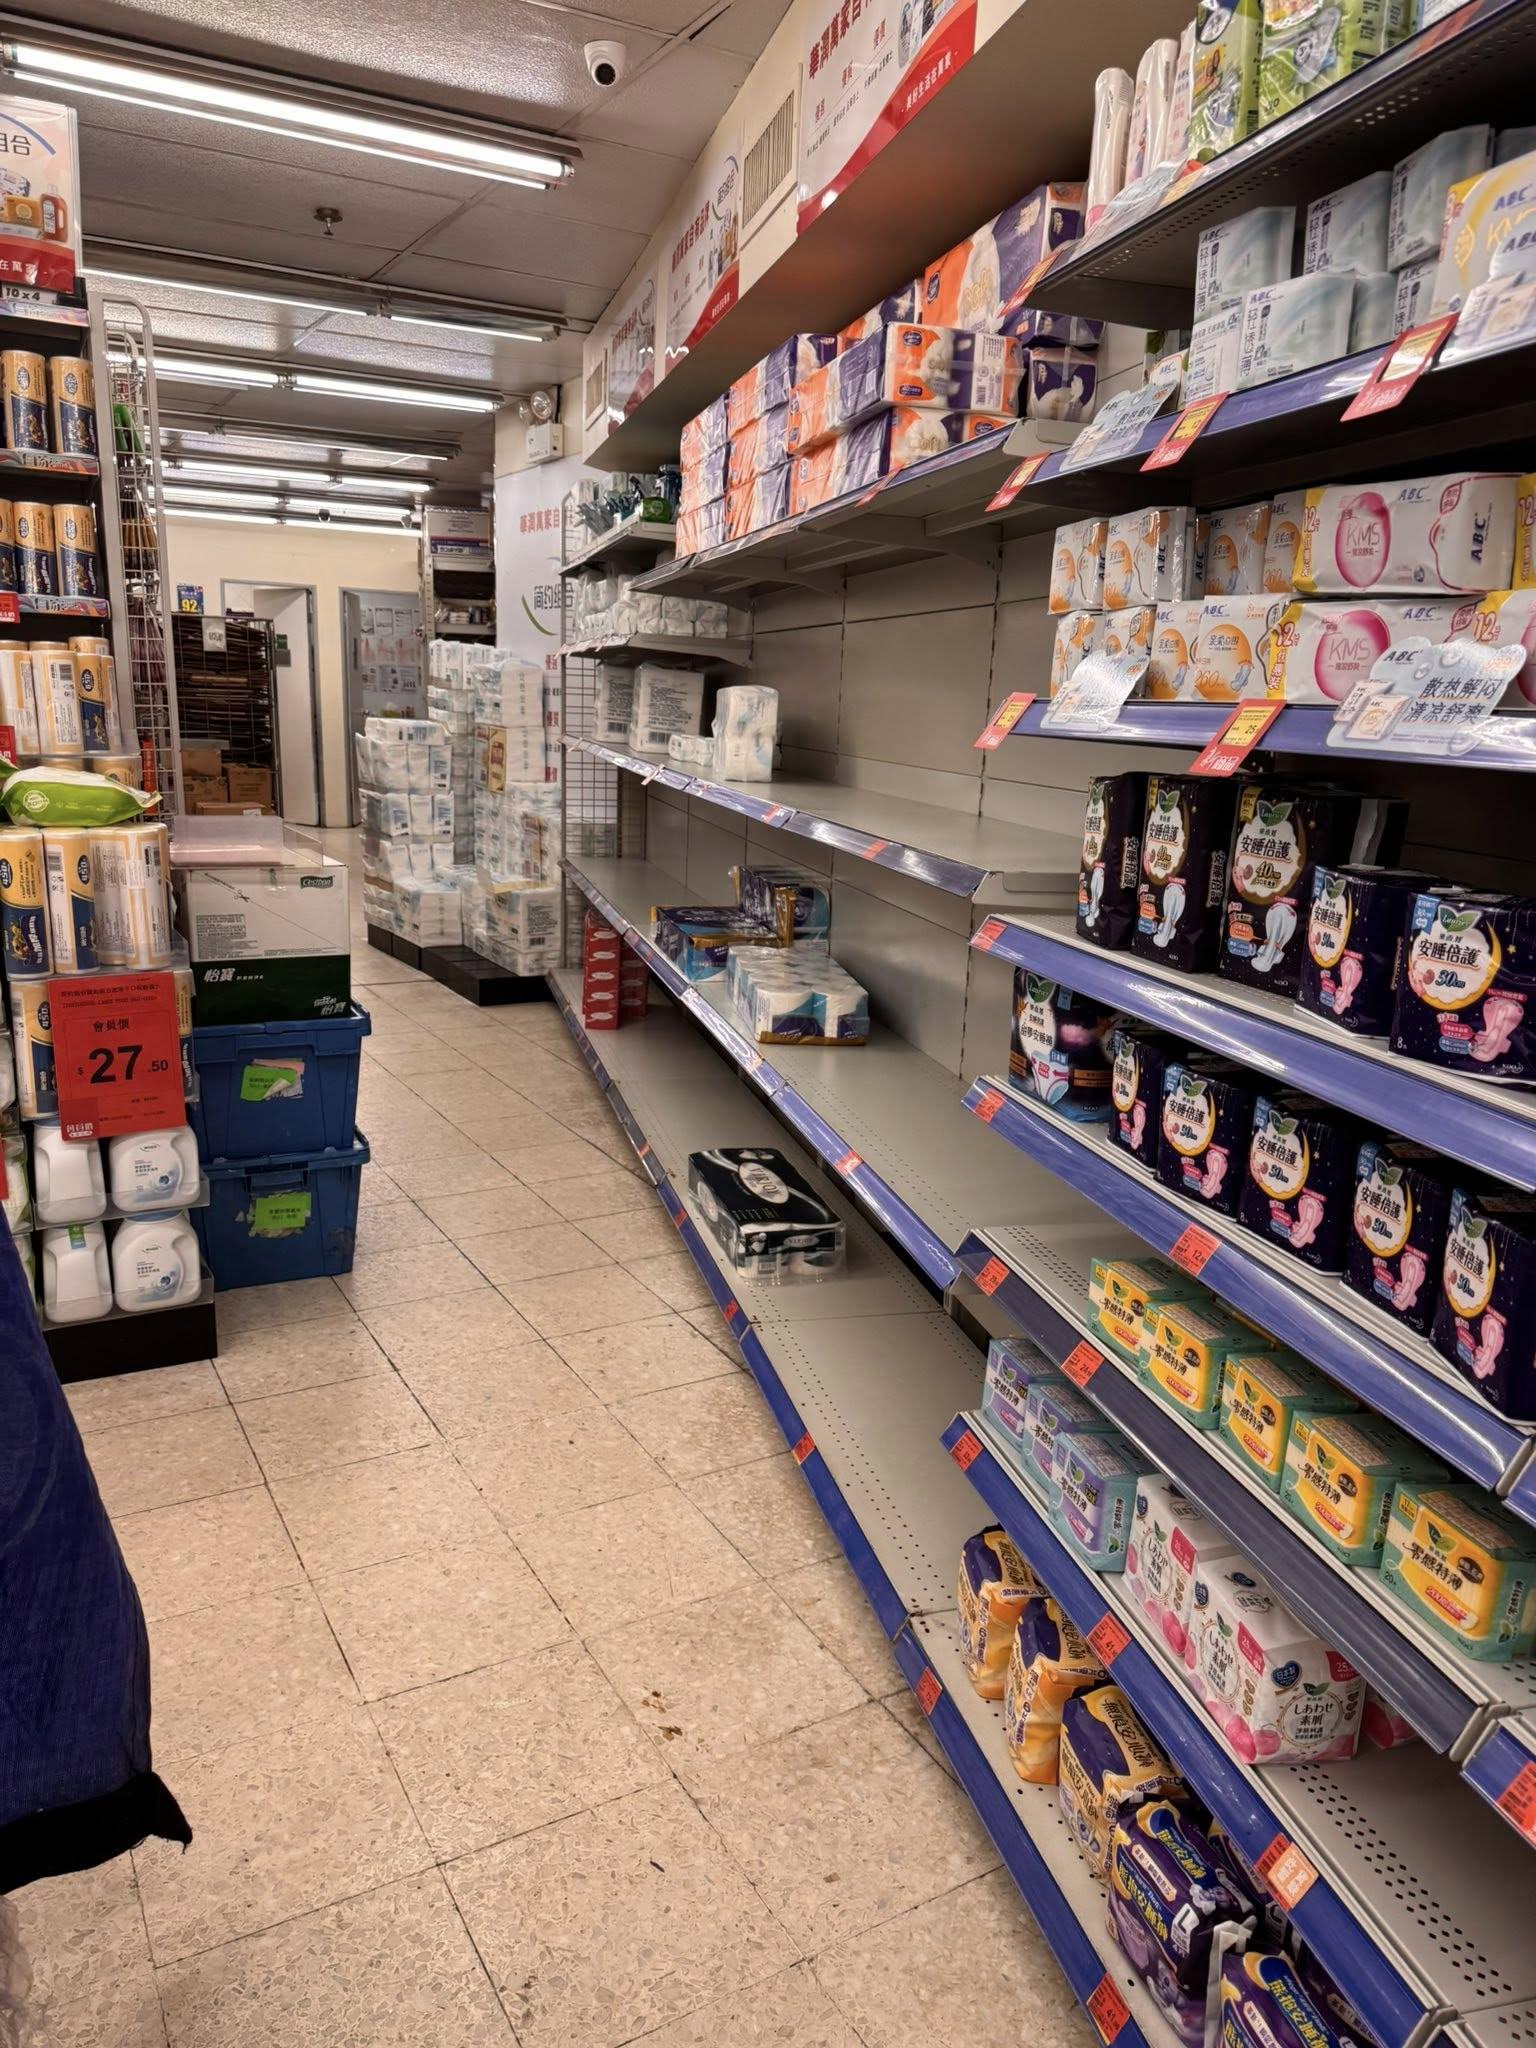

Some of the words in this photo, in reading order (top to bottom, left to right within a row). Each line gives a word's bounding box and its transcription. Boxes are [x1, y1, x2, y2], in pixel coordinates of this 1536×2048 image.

[1400, 487, 1426, 500] ABC
[1345, 522, 1381, 546] KMS
[1471, 515, 1486, 562] ABC
[182, 599, 197, 613] 92
[1203, 604, 1226, 616] ABC
[1402, 606, 1435, 619] ABC
[1329, 637, 1371, 661] KMS
[1384, 650, 1421, 663] ABC
[1149, 821, 1180, 844] 安睡倍護
[1240, 835, 1292, 860] 安睡倍護
[1312, 906, 1344, 929] 安睡倍護
[1418, 938, 1482, 968] 安睡倍護
[89, 1045, 144, 1084] 27
[1169, 1099, 1206, 1123] 安睡倍護
[1257, 1135, 1298, 1165] 安睡倍護
[1360, 1186, 1402, 1222] 安睡倍護
[1449, 1238, 1484, 1281] 安睡倍護
[1154, 1342, 1188, 1376] 零感特薄
[1034, 1424, 1055, 1451] 零感特
[1303, 1462, 1342, 1505] 零感特薄
[1409, 1541, 1464, 1591] 零感特薄
[1295, 1702, 1334, 1715] しあわせ
[1301, 1713, 1325, 1726] 素肌
